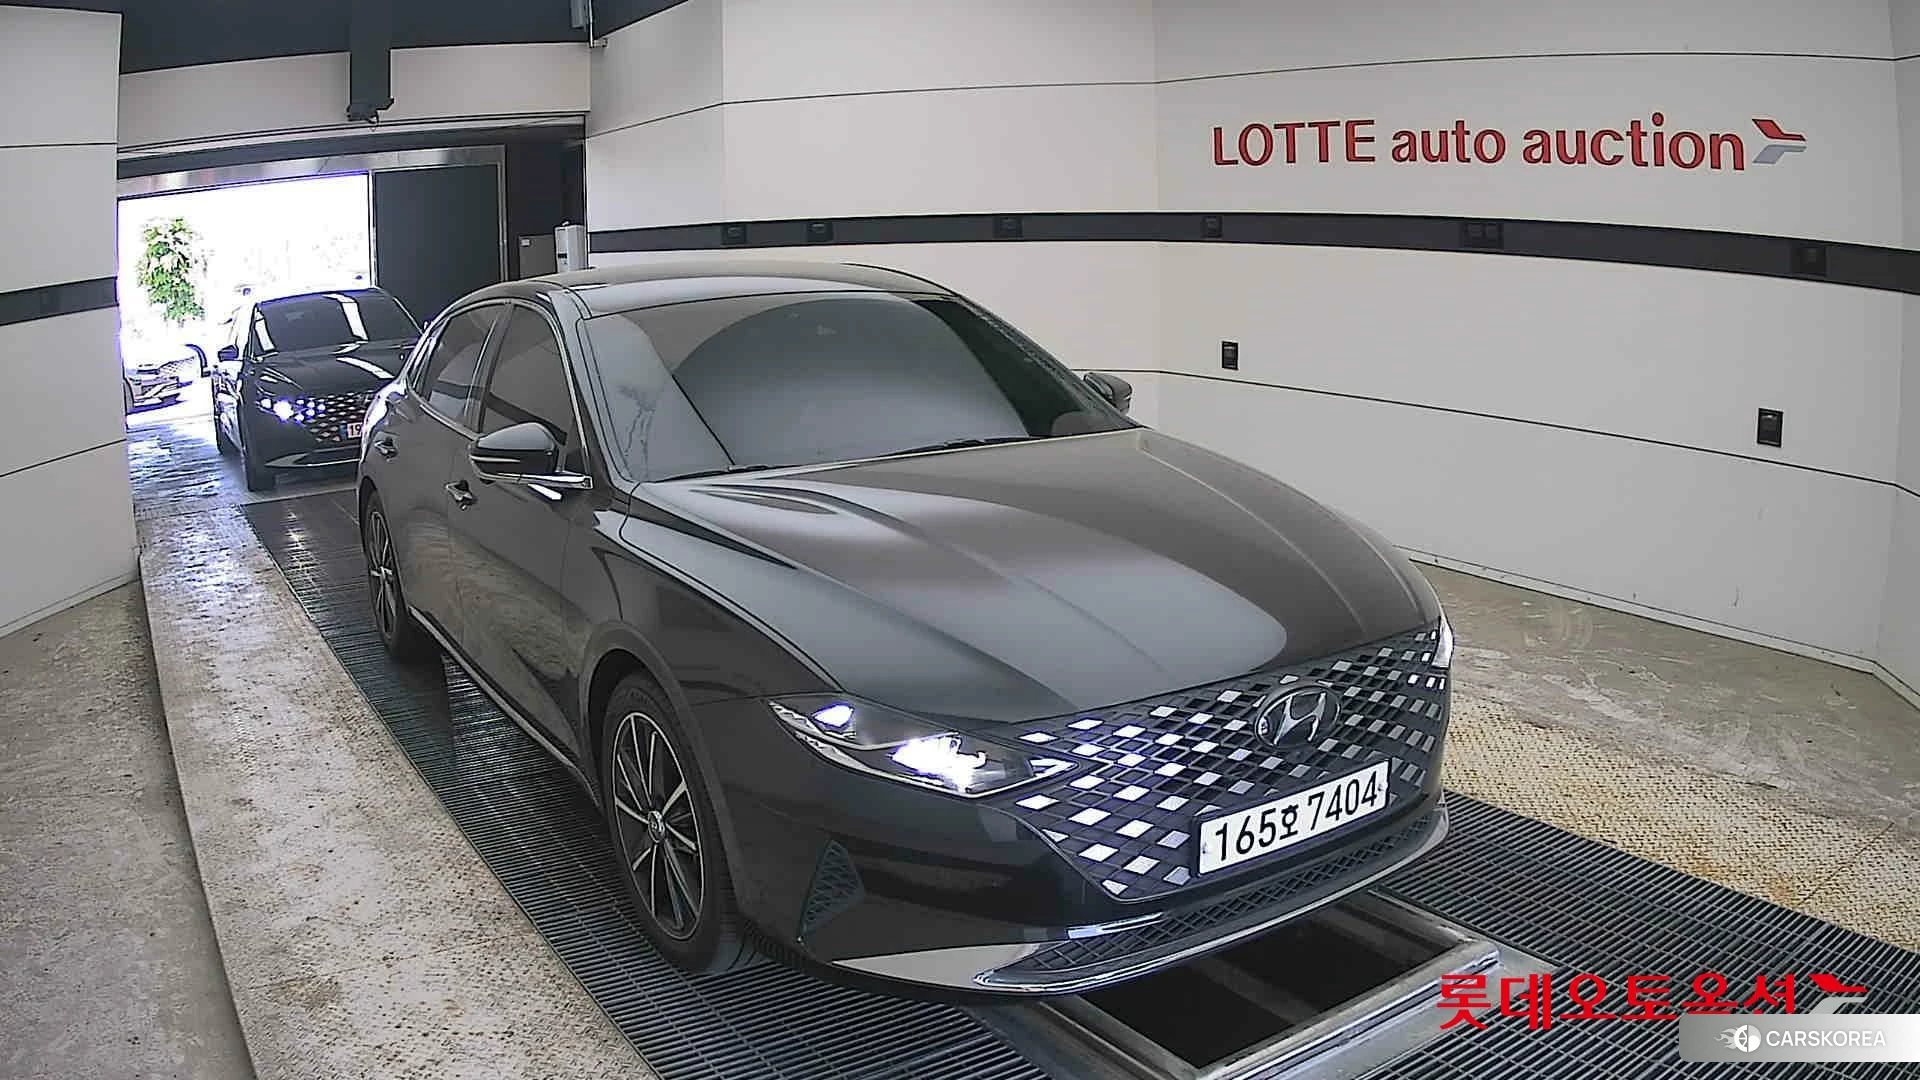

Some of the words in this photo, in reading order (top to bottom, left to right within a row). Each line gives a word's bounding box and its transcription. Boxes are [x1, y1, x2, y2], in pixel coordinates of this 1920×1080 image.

[1213, 119, 1376, 167] LOTTE
[1391, 119, 1507, 164] auto
[1521, 111, 1745, 171] auction
[1215, 804, 1299, 862] 165호
[1307, 770, 1378, 831] 7404
